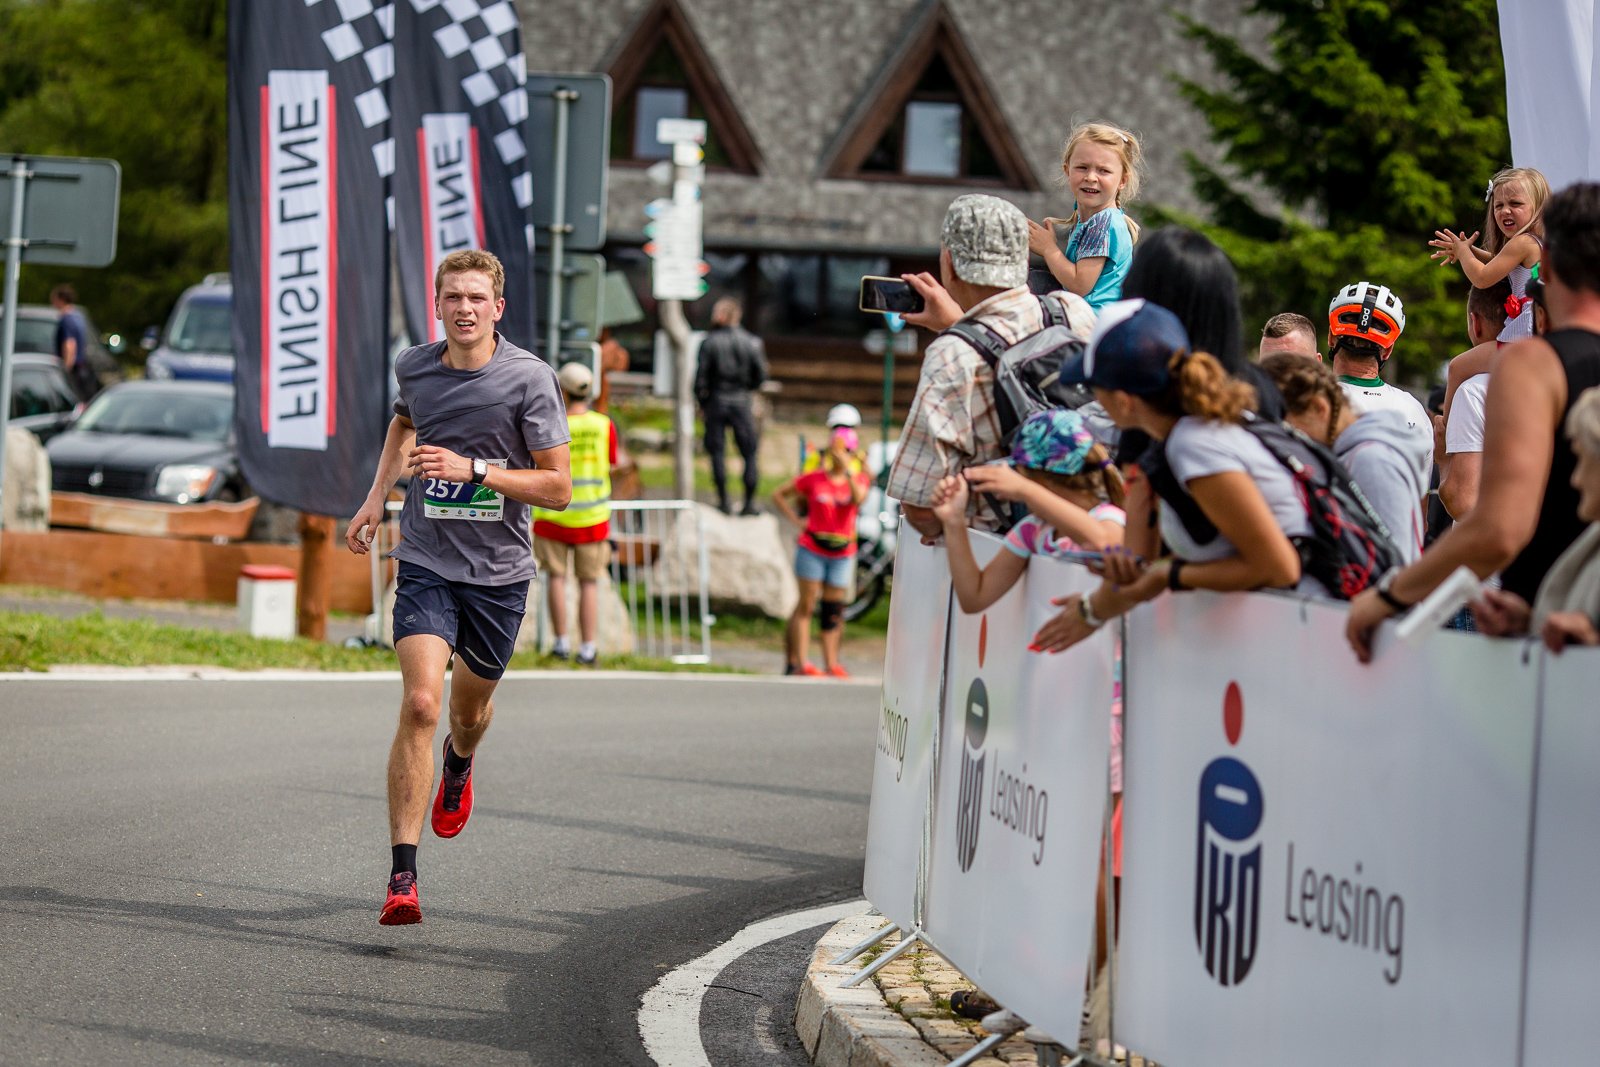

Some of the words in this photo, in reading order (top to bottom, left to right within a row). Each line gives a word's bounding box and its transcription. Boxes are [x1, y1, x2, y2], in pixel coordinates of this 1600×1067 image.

[425, 477, 464, 499] 257
[990, 748, 1049, 876] Leasing
[1285, 841, 1404, 986] Leasing
